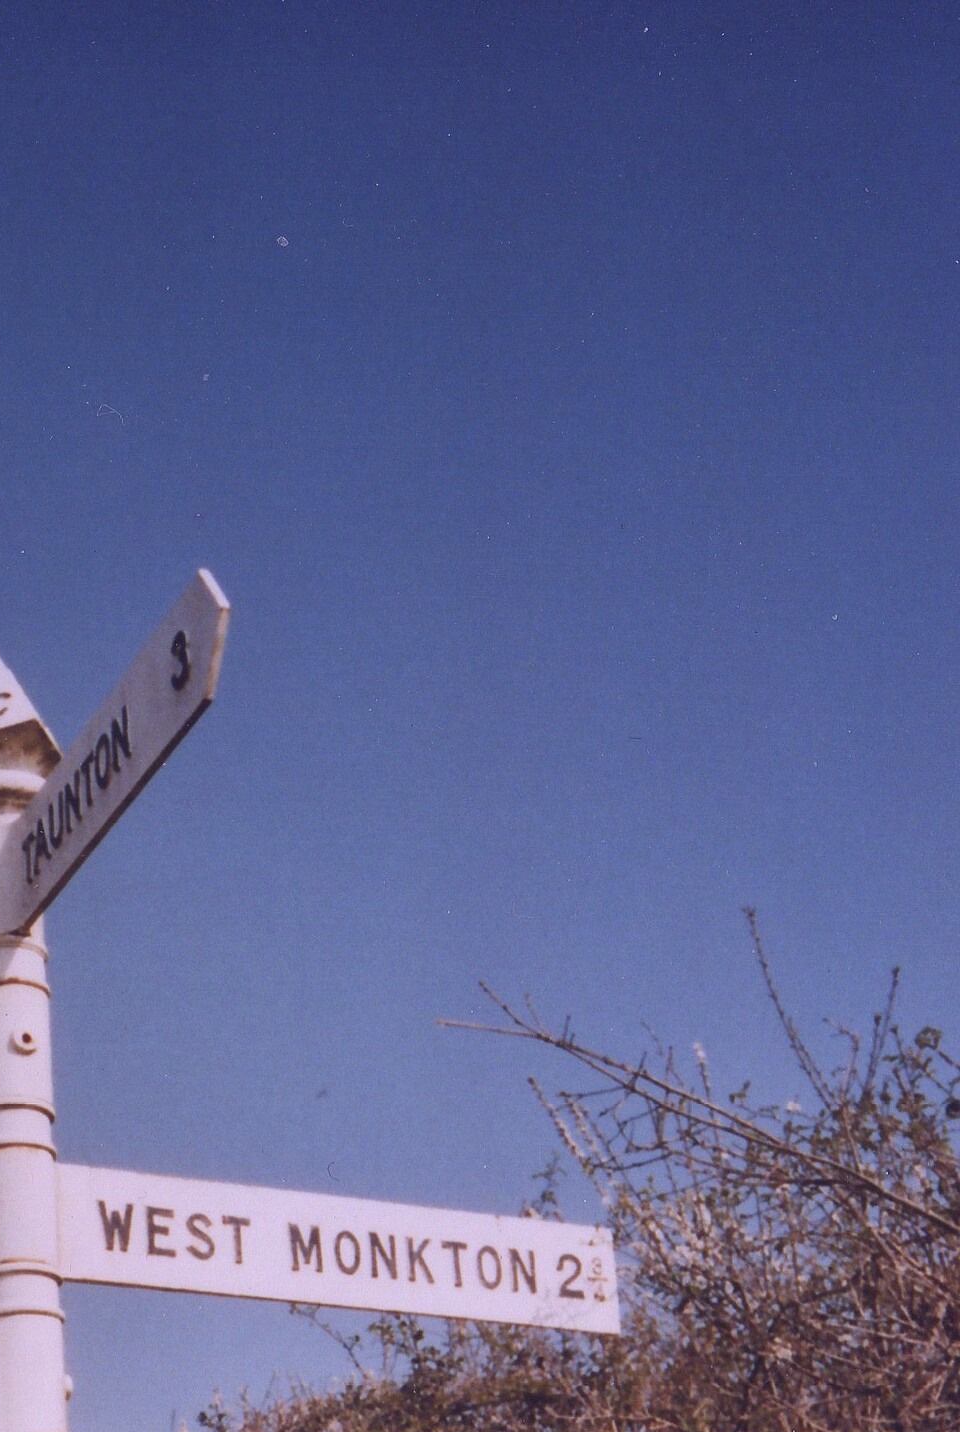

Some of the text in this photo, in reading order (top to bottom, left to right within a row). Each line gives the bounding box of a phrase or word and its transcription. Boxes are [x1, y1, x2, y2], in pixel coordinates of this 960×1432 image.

[21, 630, 190, 884] TAUNTON 3
[97, 1200, 250, 1265] WEST
[287, 1222, 538, 1295] MONKTON
